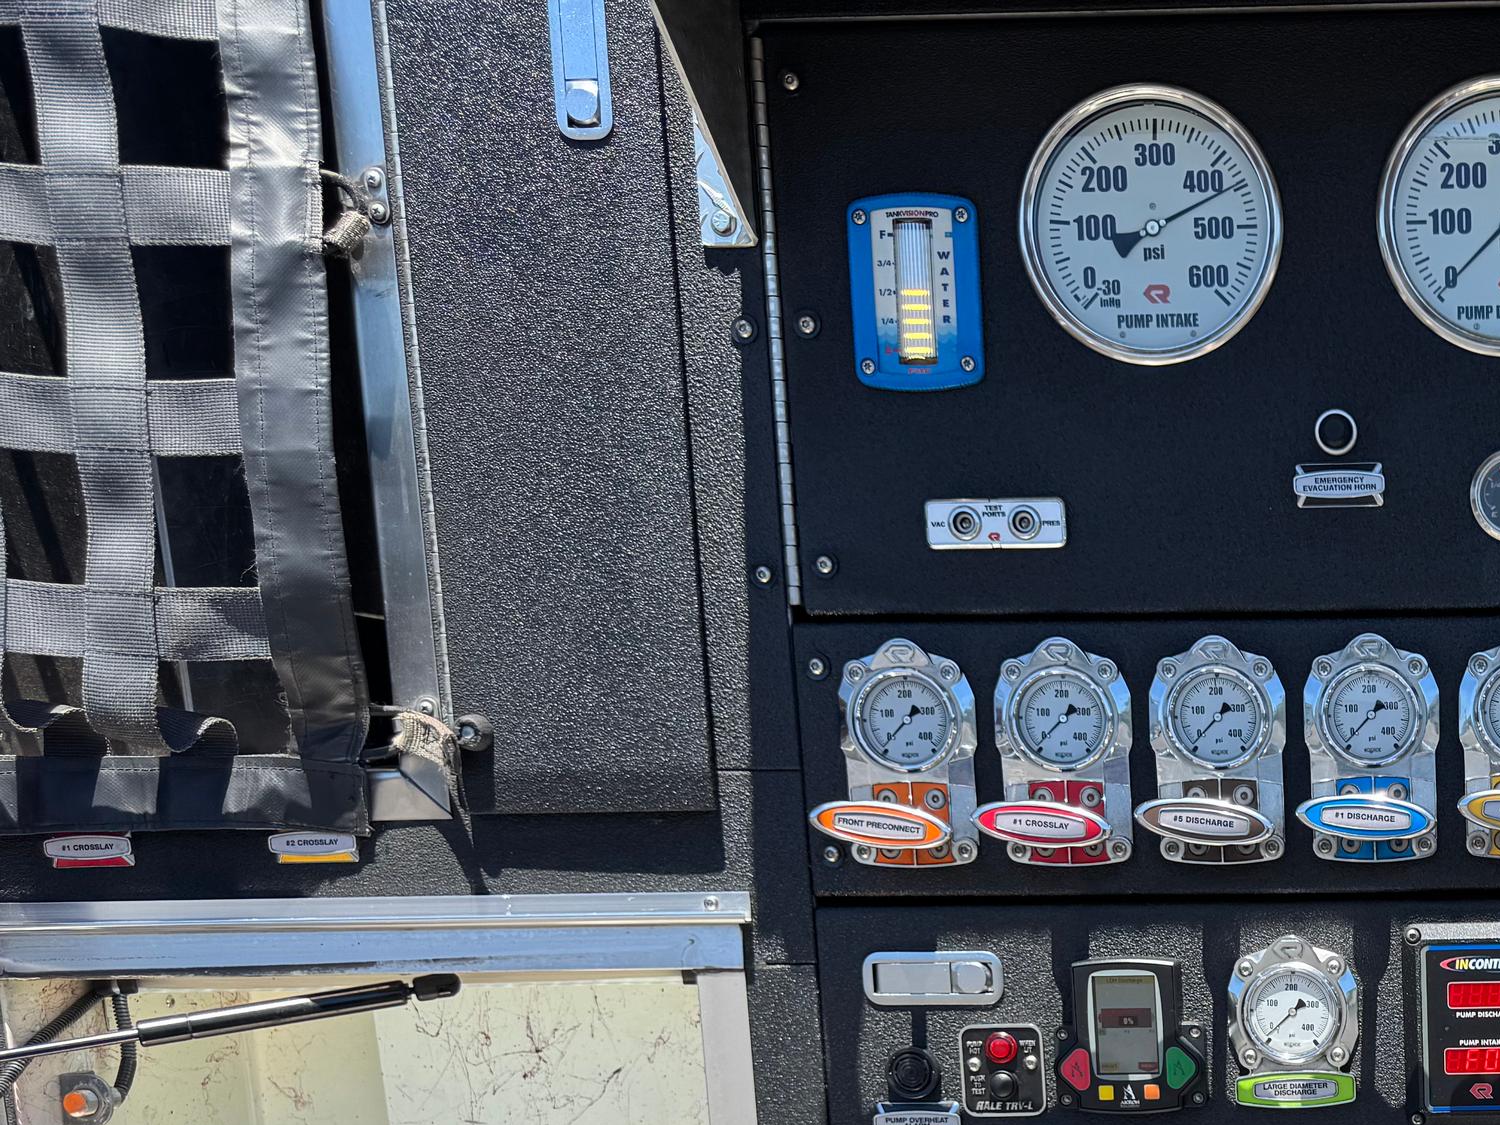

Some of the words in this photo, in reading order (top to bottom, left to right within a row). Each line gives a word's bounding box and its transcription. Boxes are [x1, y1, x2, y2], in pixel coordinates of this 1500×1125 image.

[1134, 143, 1176, 166] 300
[1081, 166, 1128, 192] 200
[1183, 170, 1223, 193] 400
[1440, 162, 1487, 189] 200
[1073, 214, 1117, 240] 100
[1194, 216, 1234, 239] 500
[1428, 208, 1472, 234] 100
[1143, 244, 1165, 261] psi
[1084, 266, 1096, 288] 0
[1189, 265, 1228, 288] 600
[1445, 266, 1458, 288] 0
[937, 251, 951, 324] WATER
[1100, 296, 1121, 308] inHg
[1117, 313, 1153, 328] PUMP
[1156, 313, 1199, 328] INTAKE
[1457, 305, 1493, 320] PUMP
[1303, 484, 1352, 492] EVACUATION
[838, 817, 865, 828] FRONT
[866, 821, 920, 834] PRECONNECT
[1013, 819, 1023, 827] #1
[1025, 820, 1069, 830] CROSSLAY
[1185, 817, 1234, 828] DISCHARGE
[1347, 813, 1395, 823] DISCHARGE
[73, 843, 114, 851] CROSSLAY
[298, 838, 338, 846] CROSSLAY
